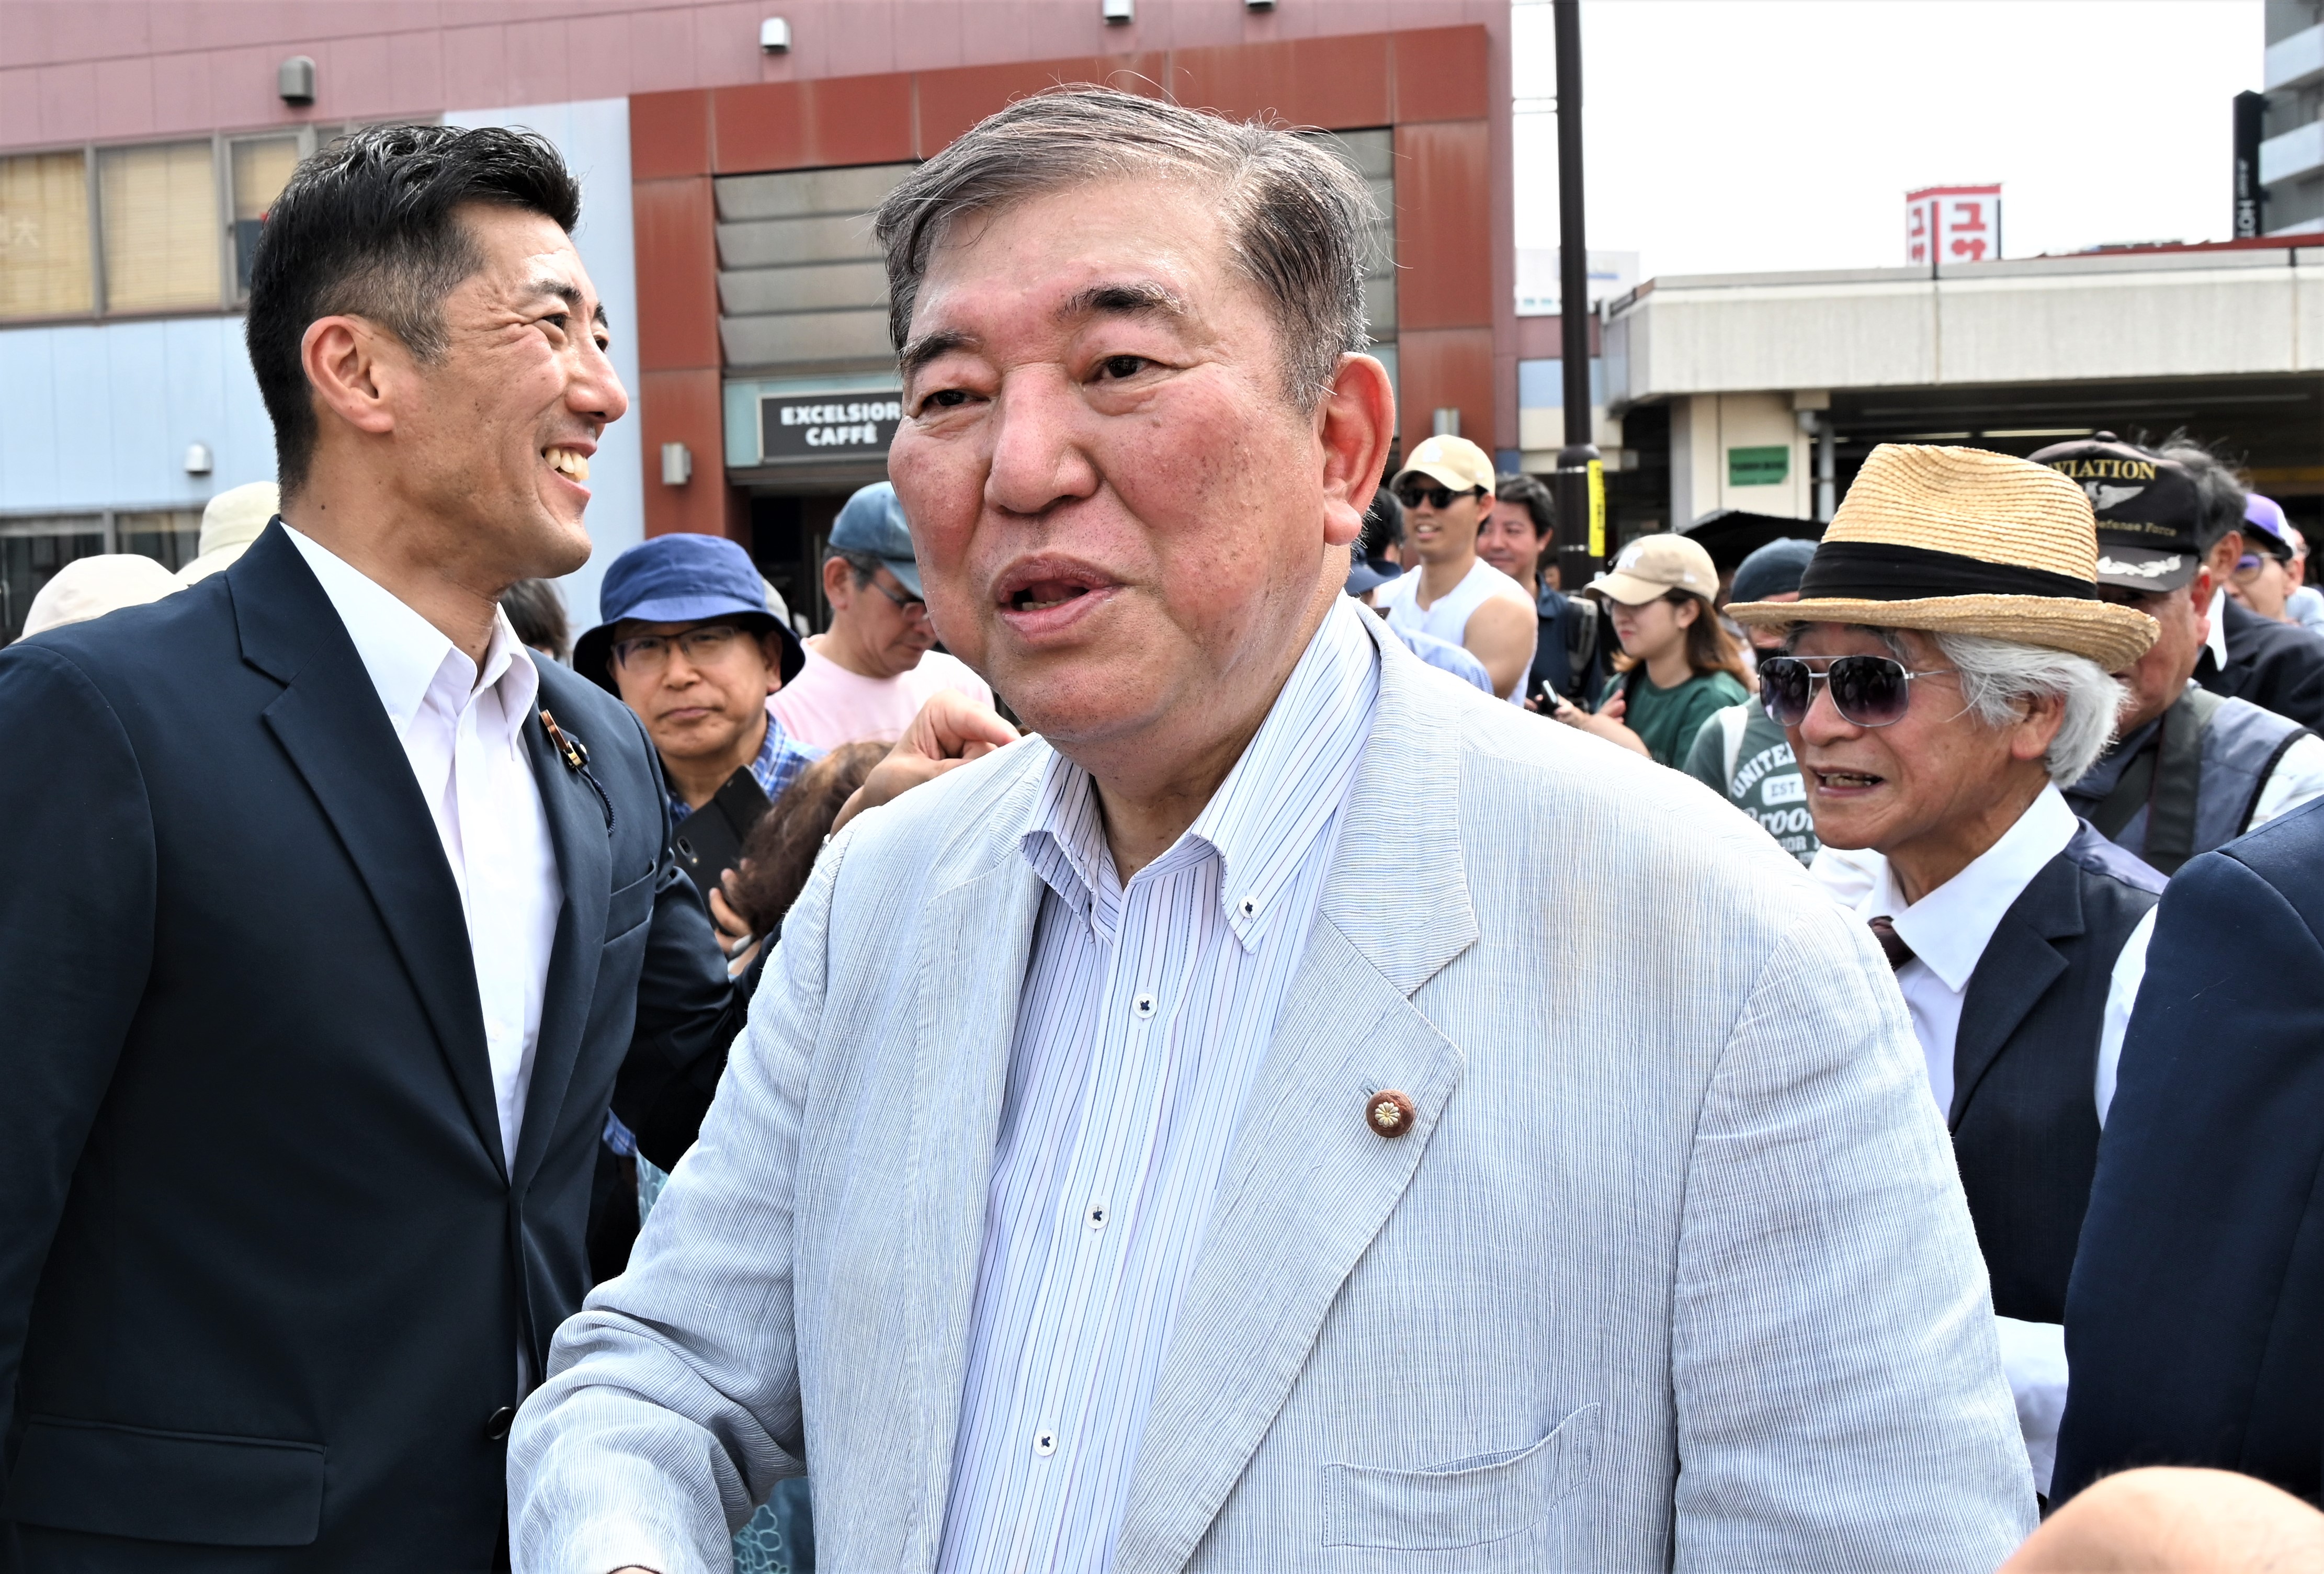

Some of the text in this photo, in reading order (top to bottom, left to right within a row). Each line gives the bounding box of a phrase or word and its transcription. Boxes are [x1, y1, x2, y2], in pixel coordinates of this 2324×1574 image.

[781, 401, 902, 426] EXCELSIOR
[2049, 459, 2157, 481] VIATION
[2095, 519, 2143, 532] efense
[1771, 782, 1796, 797] EST
